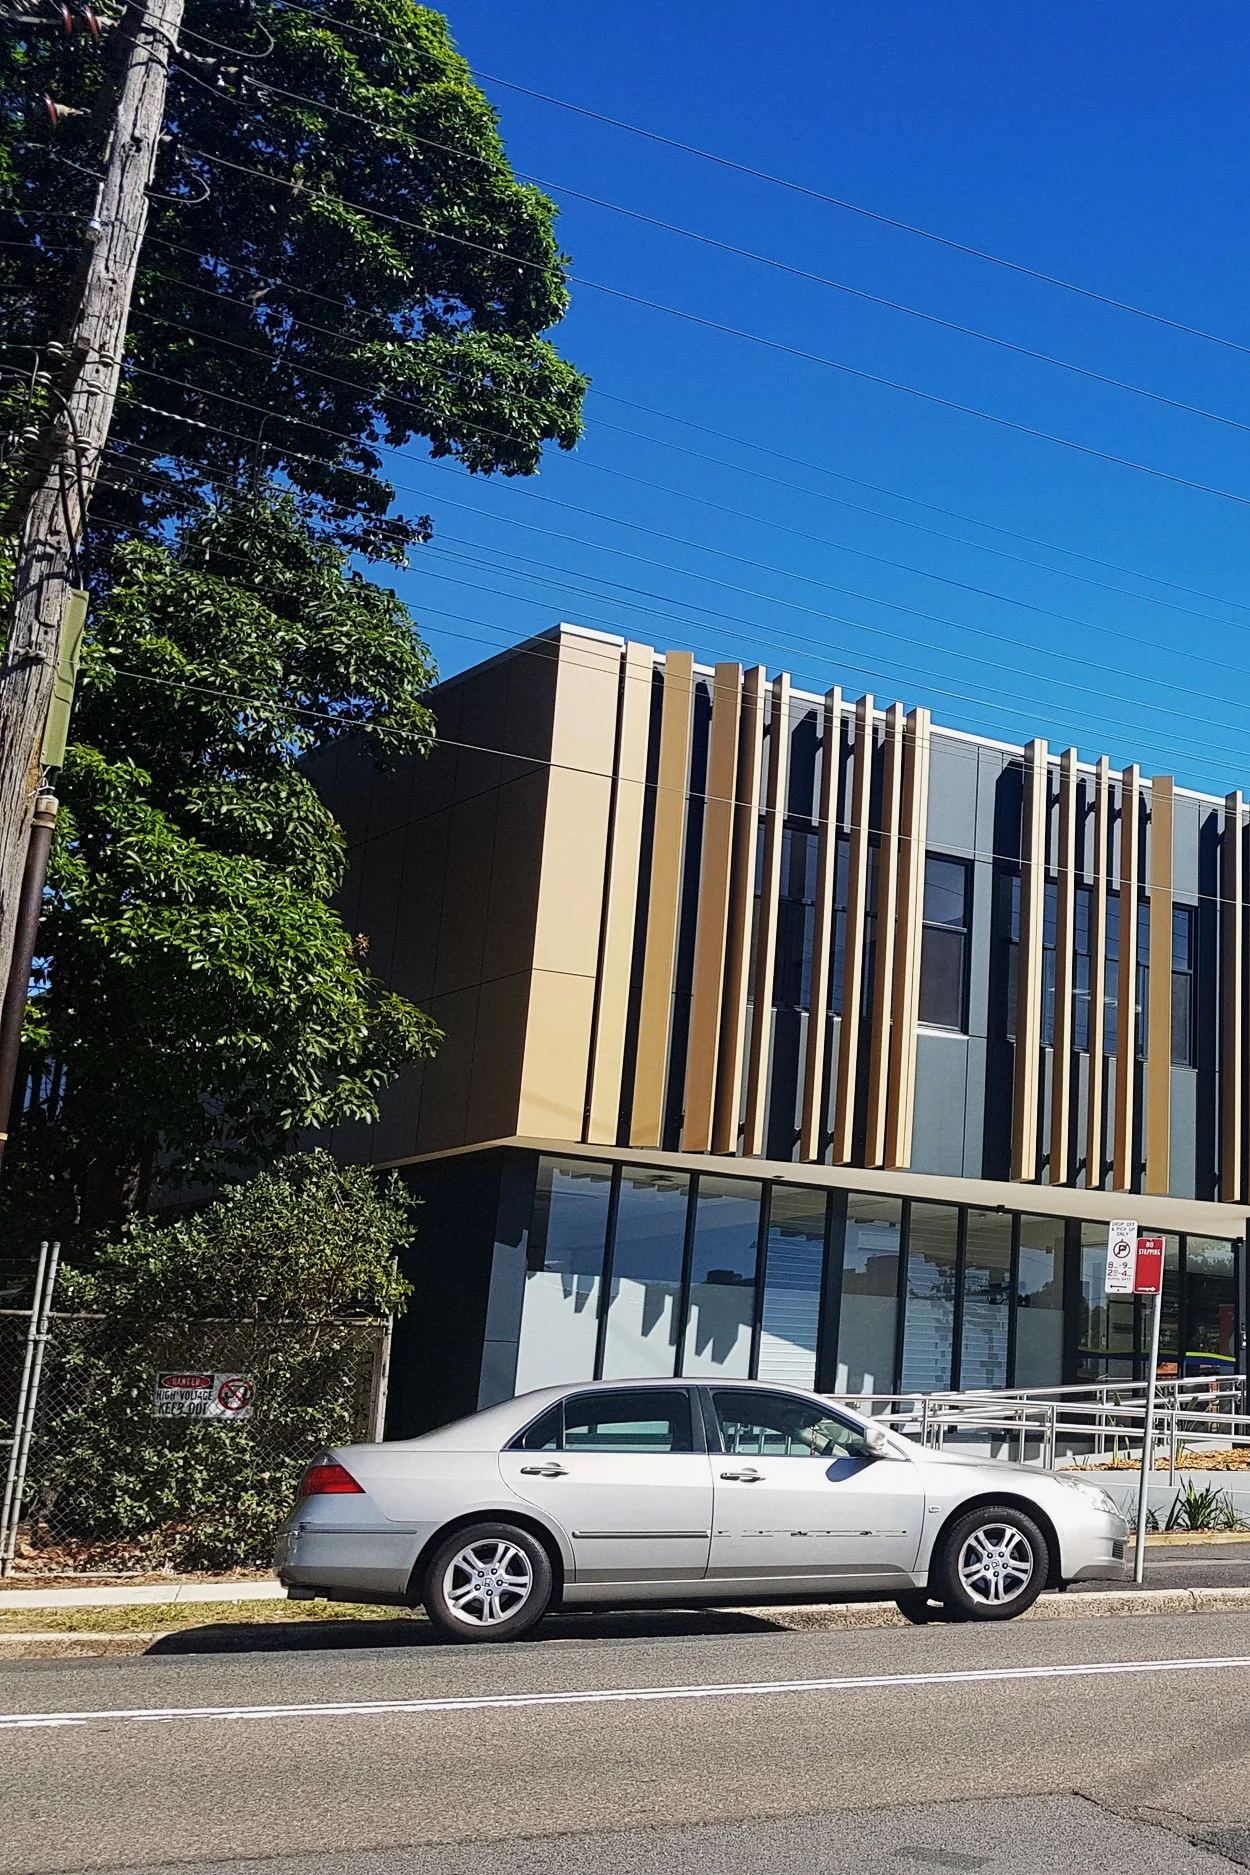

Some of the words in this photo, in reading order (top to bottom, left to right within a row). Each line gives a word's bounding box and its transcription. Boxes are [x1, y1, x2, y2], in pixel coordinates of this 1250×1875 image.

[172, 1377, 201, 1386] DANGER
[156, 1390, 176, 1400] HIGH
[180, 1390, 213, 1401] VOLTAGE
[158, 1401, 185, 1414] KEEP
[189, 1401, 208, 1415] OUT
